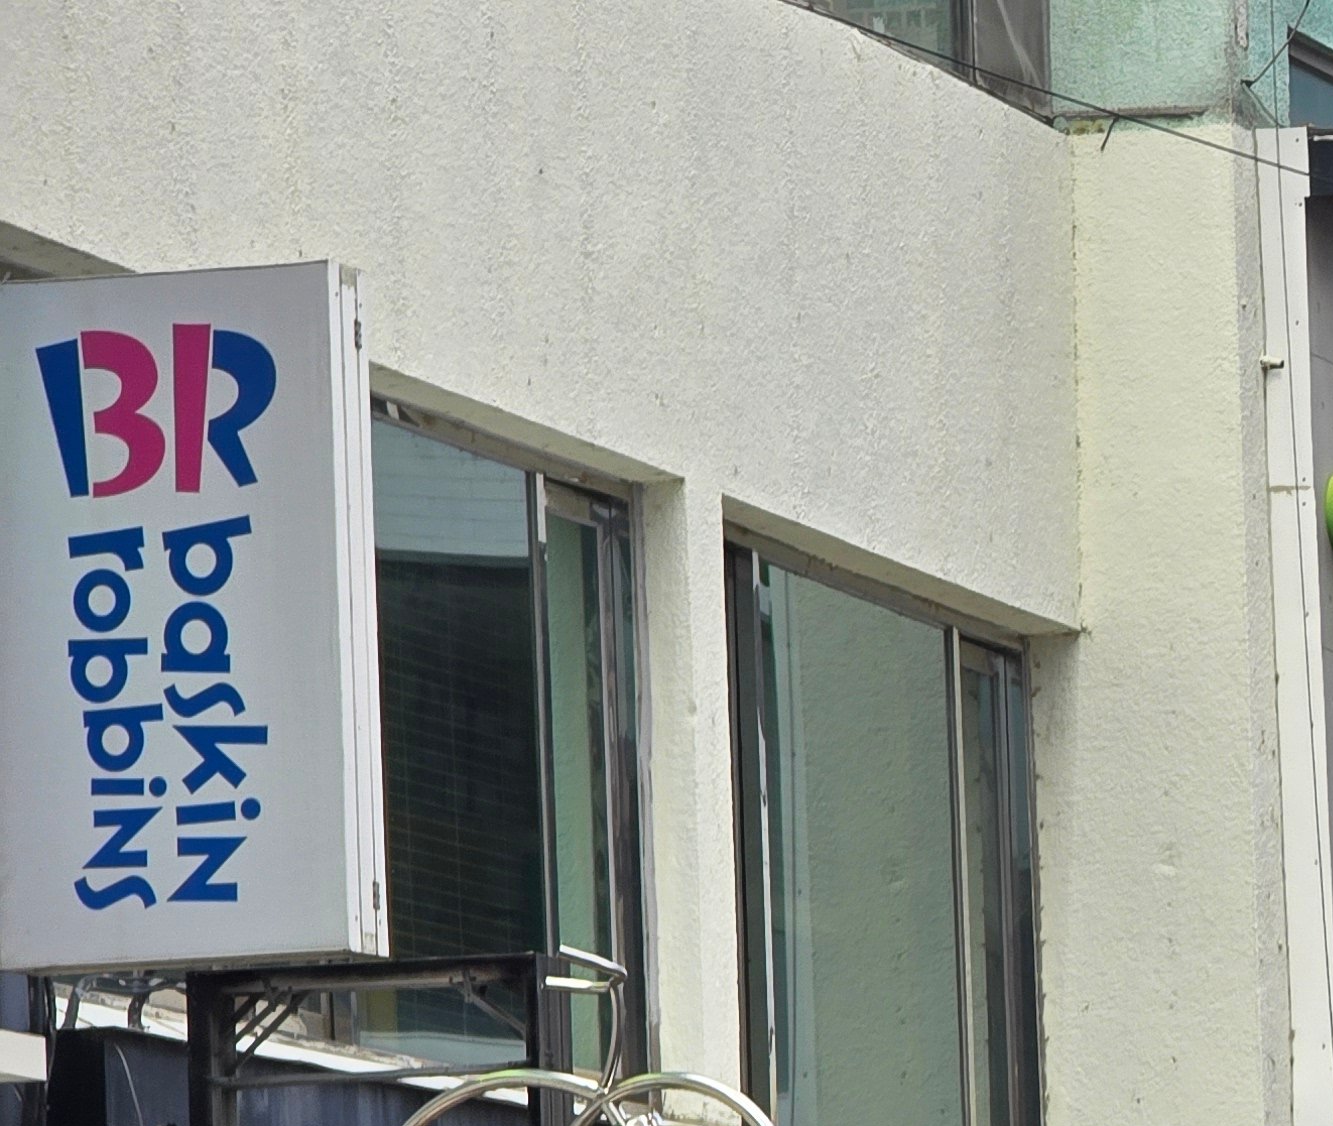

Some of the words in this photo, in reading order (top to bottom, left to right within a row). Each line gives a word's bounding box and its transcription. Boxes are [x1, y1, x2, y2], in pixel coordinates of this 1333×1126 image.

[36, 323, 277, 497] BR
[68, 525, 167, 911] robbins
[161, 514, 269, 902] baskin
